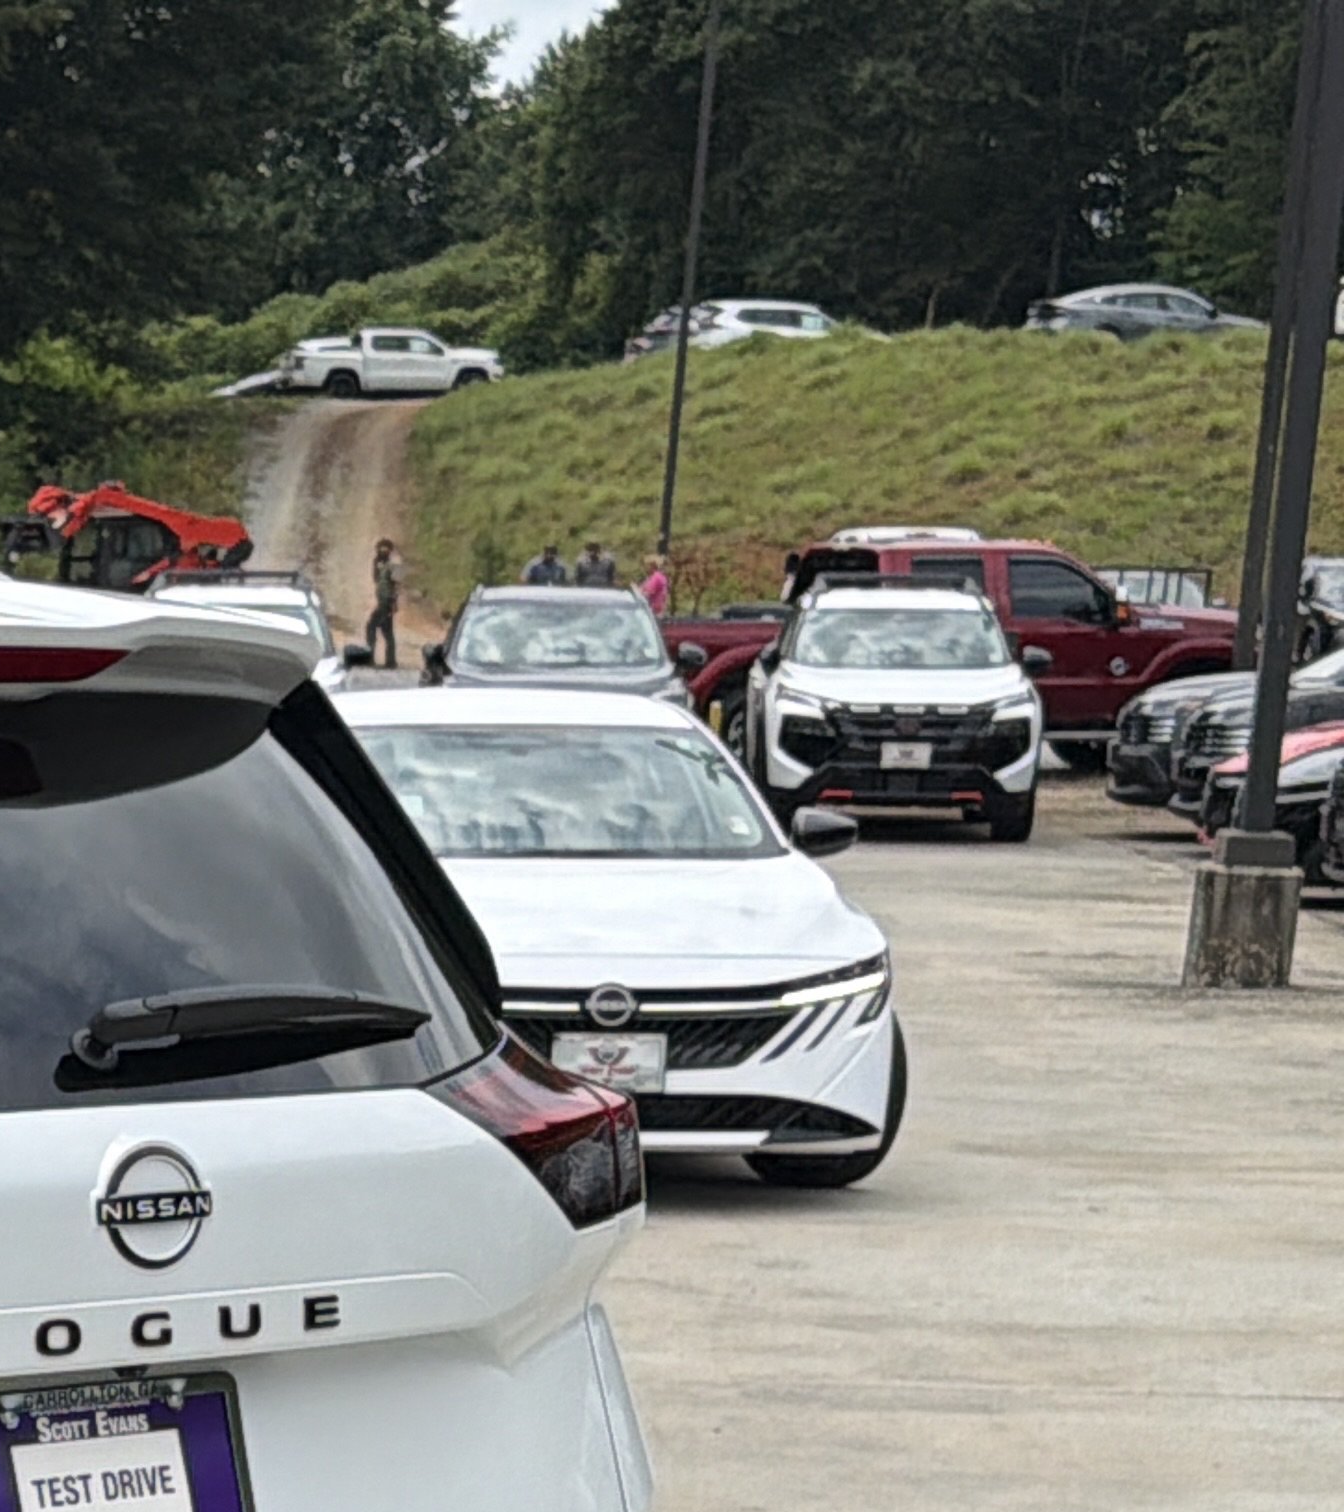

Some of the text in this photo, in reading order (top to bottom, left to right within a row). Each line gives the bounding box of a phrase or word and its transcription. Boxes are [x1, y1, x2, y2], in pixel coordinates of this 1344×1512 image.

[100, 1195, 212, 1222] NISSAN
[35, 1411, 150, 1443] SCOTT EVANS
[31, 1464, 176, 1510] TEST DRIVE
